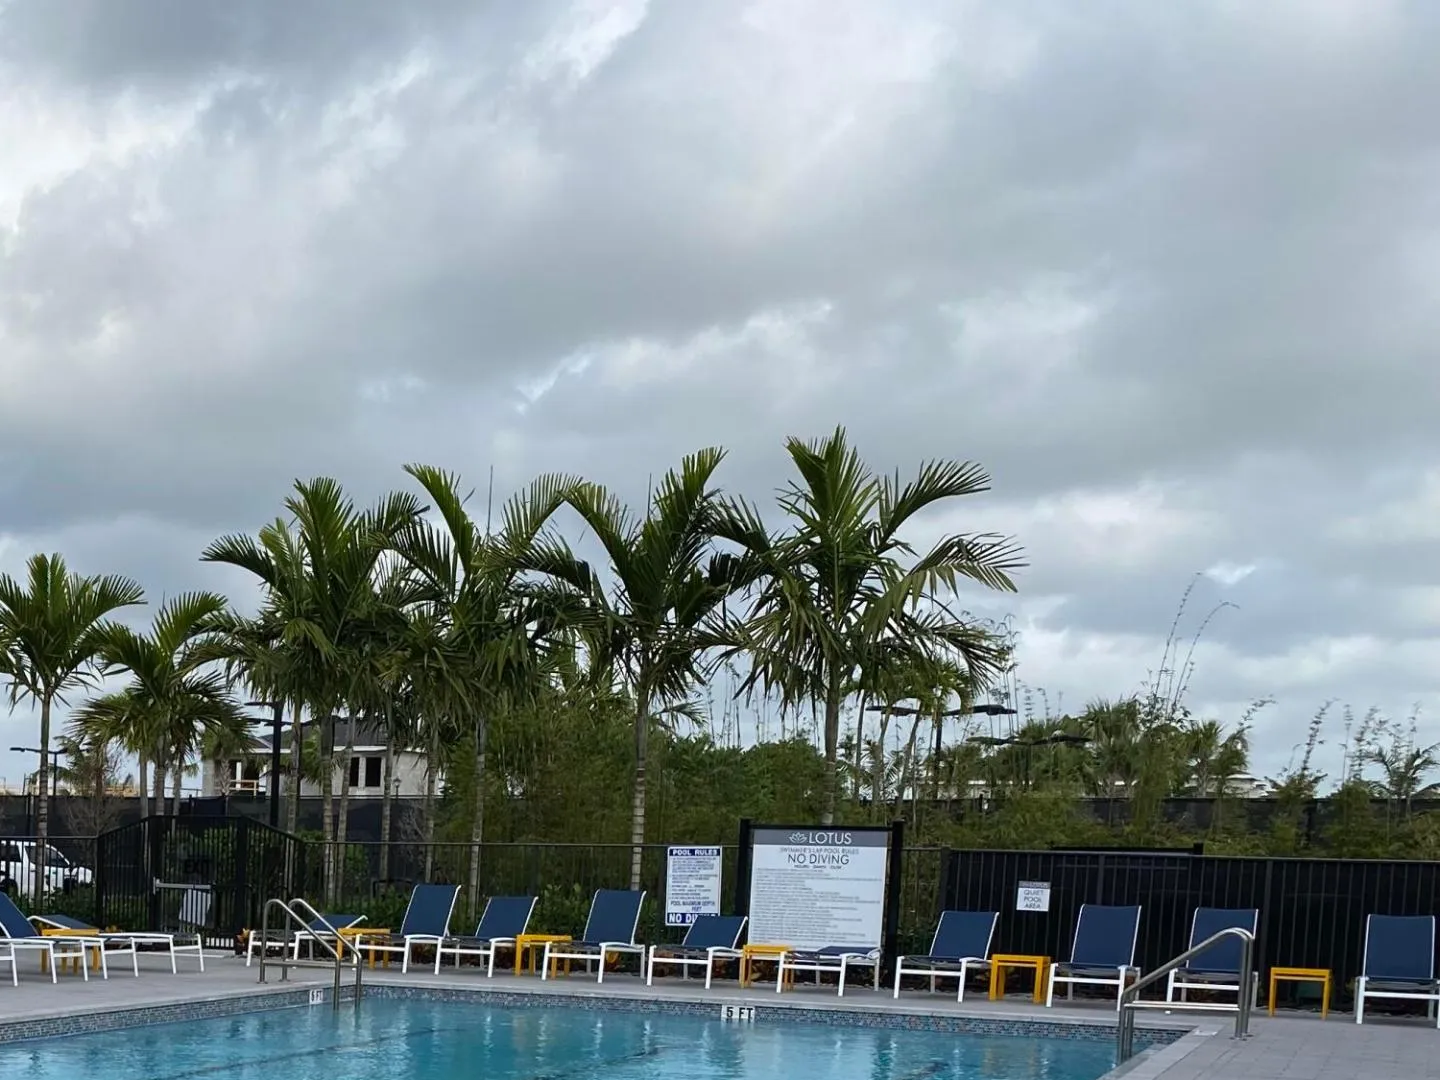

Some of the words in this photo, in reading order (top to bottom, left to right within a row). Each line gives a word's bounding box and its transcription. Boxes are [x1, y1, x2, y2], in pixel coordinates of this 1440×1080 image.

[809, 832, 852, 844] LOTUS
[788, 854, 806, 864] NO
[809, 854, 850, 865] DIVING
[669, 913, 682, 923] NO
[726, 1006, 733, 1018] 5
